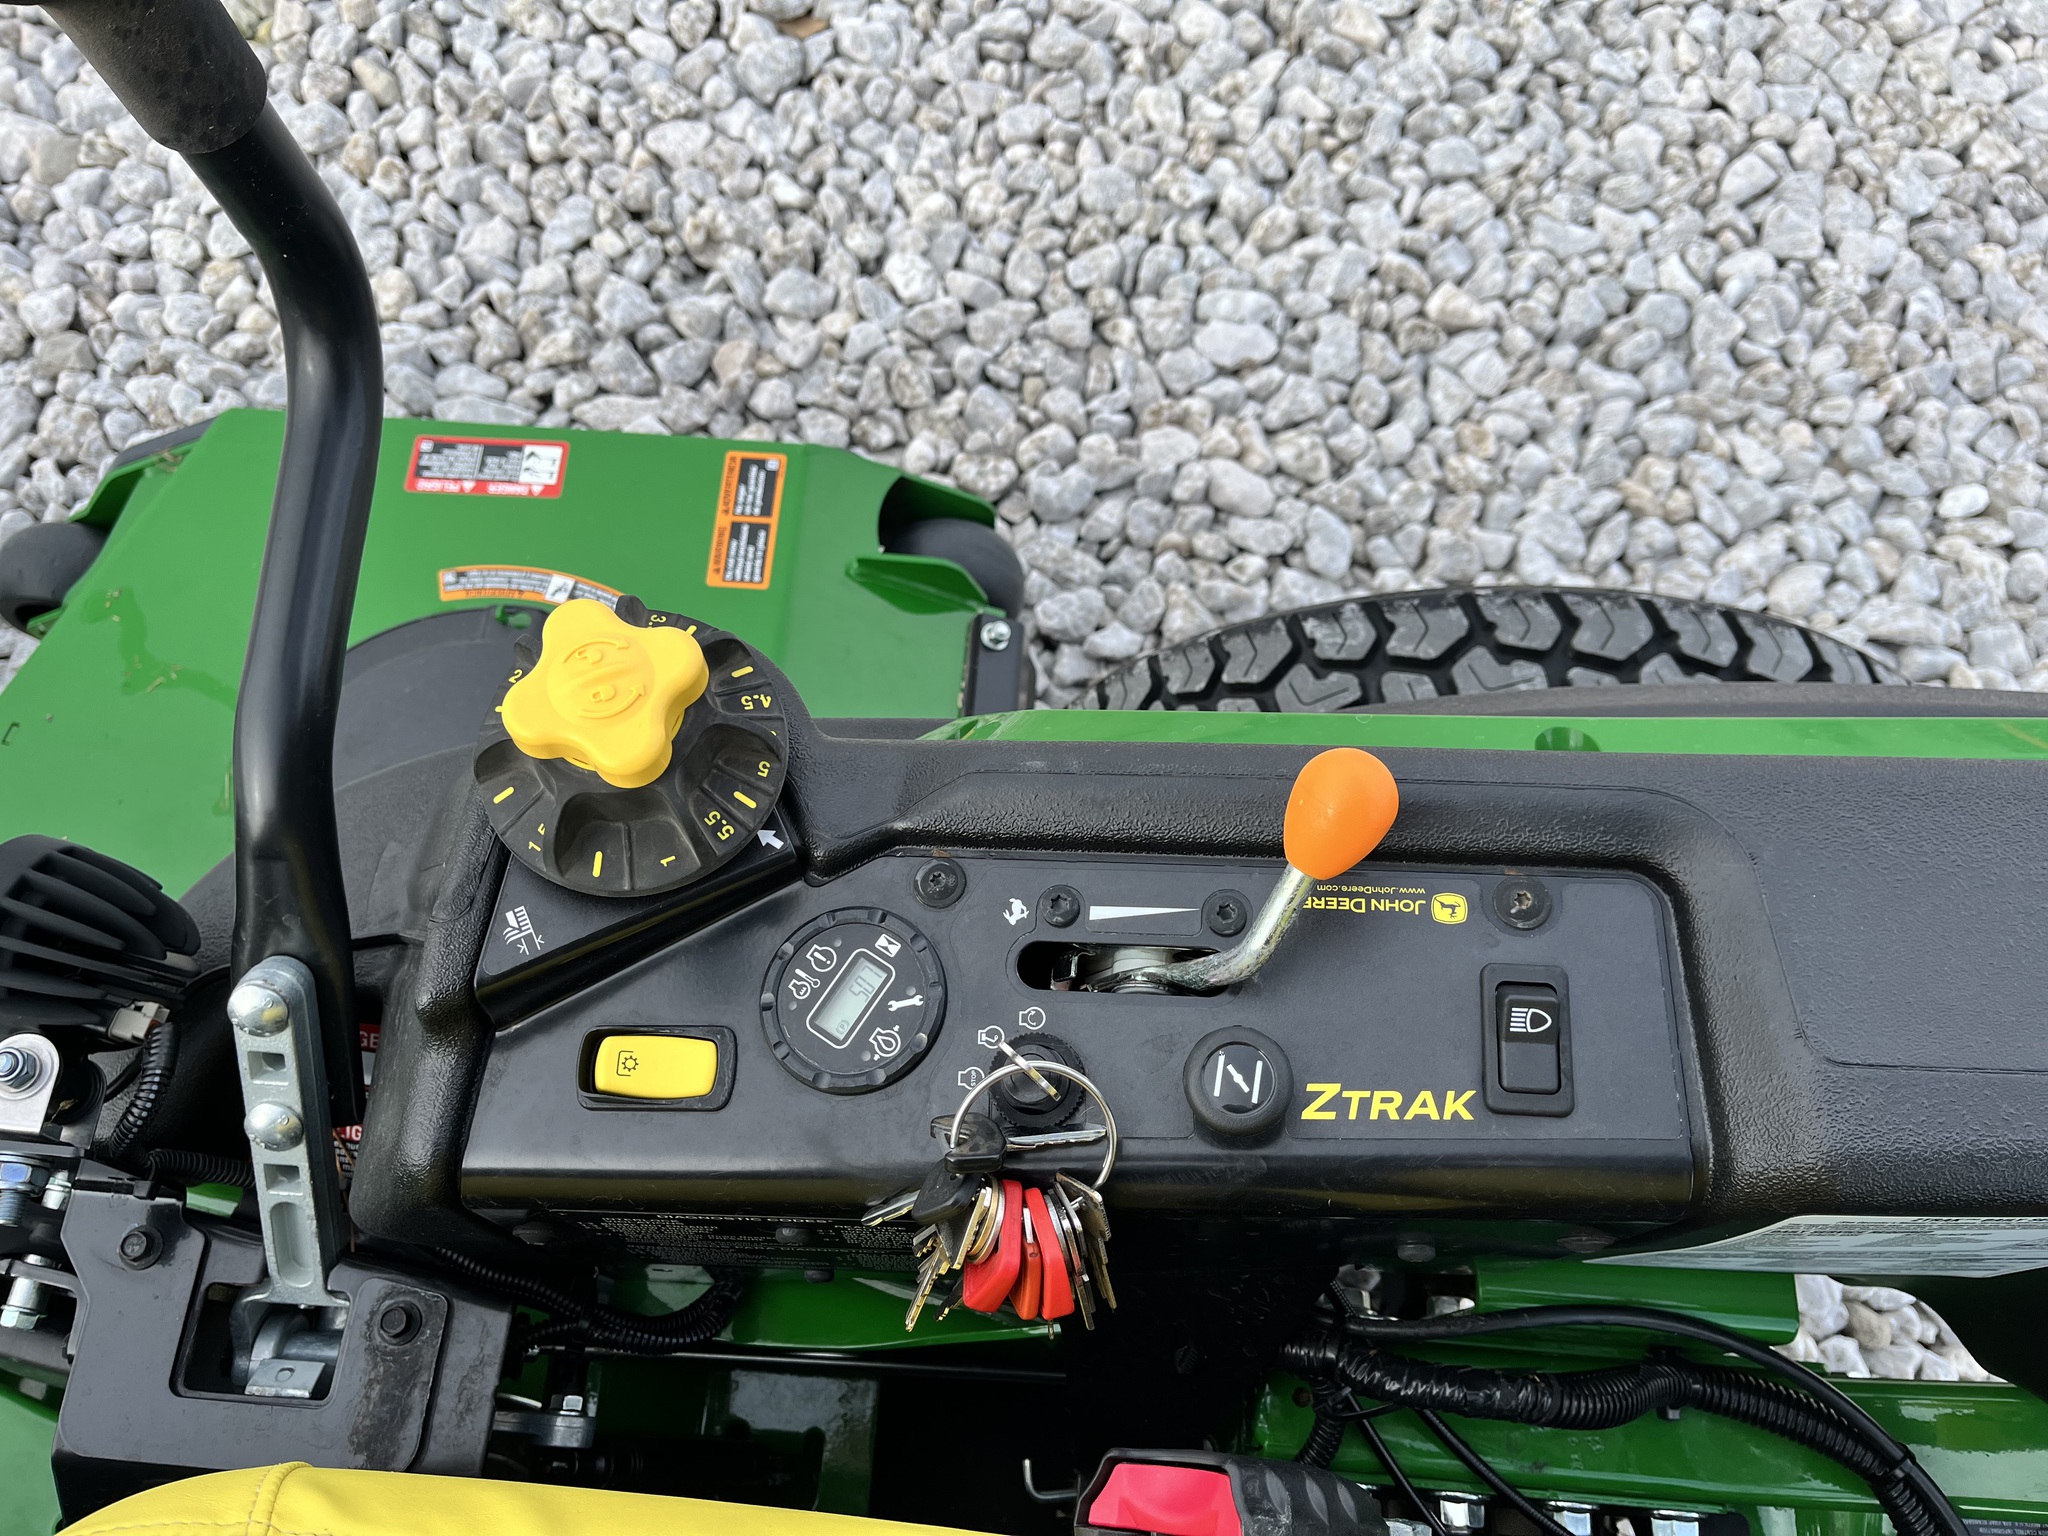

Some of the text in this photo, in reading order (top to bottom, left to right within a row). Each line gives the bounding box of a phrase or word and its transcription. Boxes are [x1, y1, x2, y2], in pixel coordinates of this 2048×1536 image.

[741, 694, 772, 710] 4.5
[758, 760, 771, 777] 5
[704, 810, 735, 841] 5.5
[660, 855, 676, 867] 1
[1316, 884, 1426, 894] www.JohnDeere.com
[1371, 898, 1427, 915] JOHN
[1301, 1083, 1476, 1121] ZTRAK
